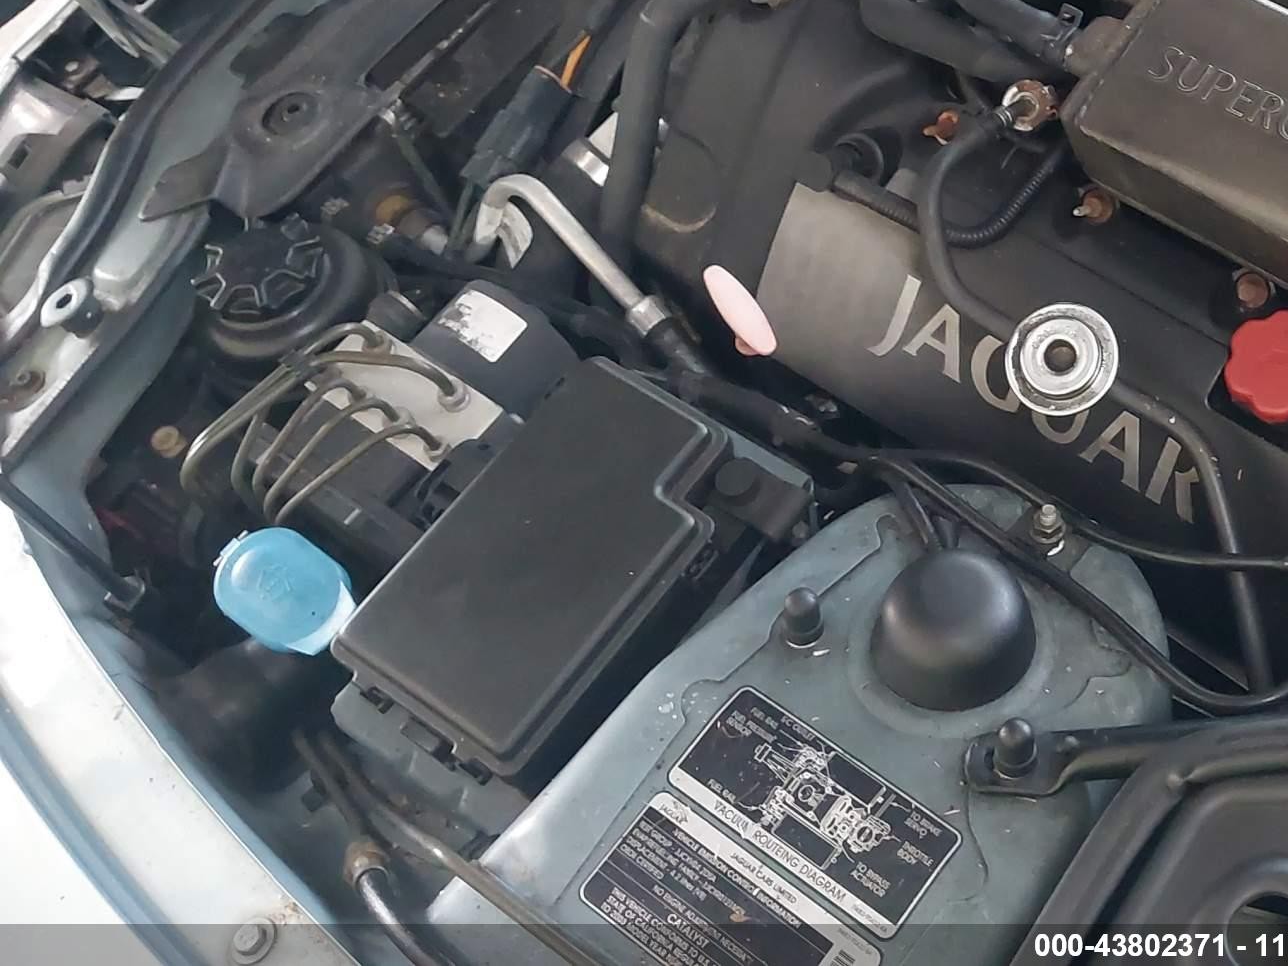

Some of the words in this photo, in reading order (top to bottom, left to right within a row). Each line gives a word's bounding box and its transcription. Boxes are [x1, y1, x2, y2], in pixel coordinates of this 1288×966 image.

[909, 810, 922, 822] TO
[729, 851, 757, 874] JAGUAR
[754, 870, 774, 887] CARS
[772, 883, 798, 904] LIMITED
[751, 828, 801, 869] ROUTEING
[798, 863, 847, 902] DIAGRAM
[855, 861, 867, 873] TO
[651, 883, 664, 896] NO
[610, 887, 627, 902] THIS
[623, 896, 653, 921] VEHICLE
[649, 917, 691, 950] CONFORMS
[686, 946, 699, 958] TO
[755, 891, 803, 928] INFORMATION
[623, 908, 637, 921] OF
[632, 916, 675, 951] CALIFORNIA
[664, 911, 710, 949] CATALYST
